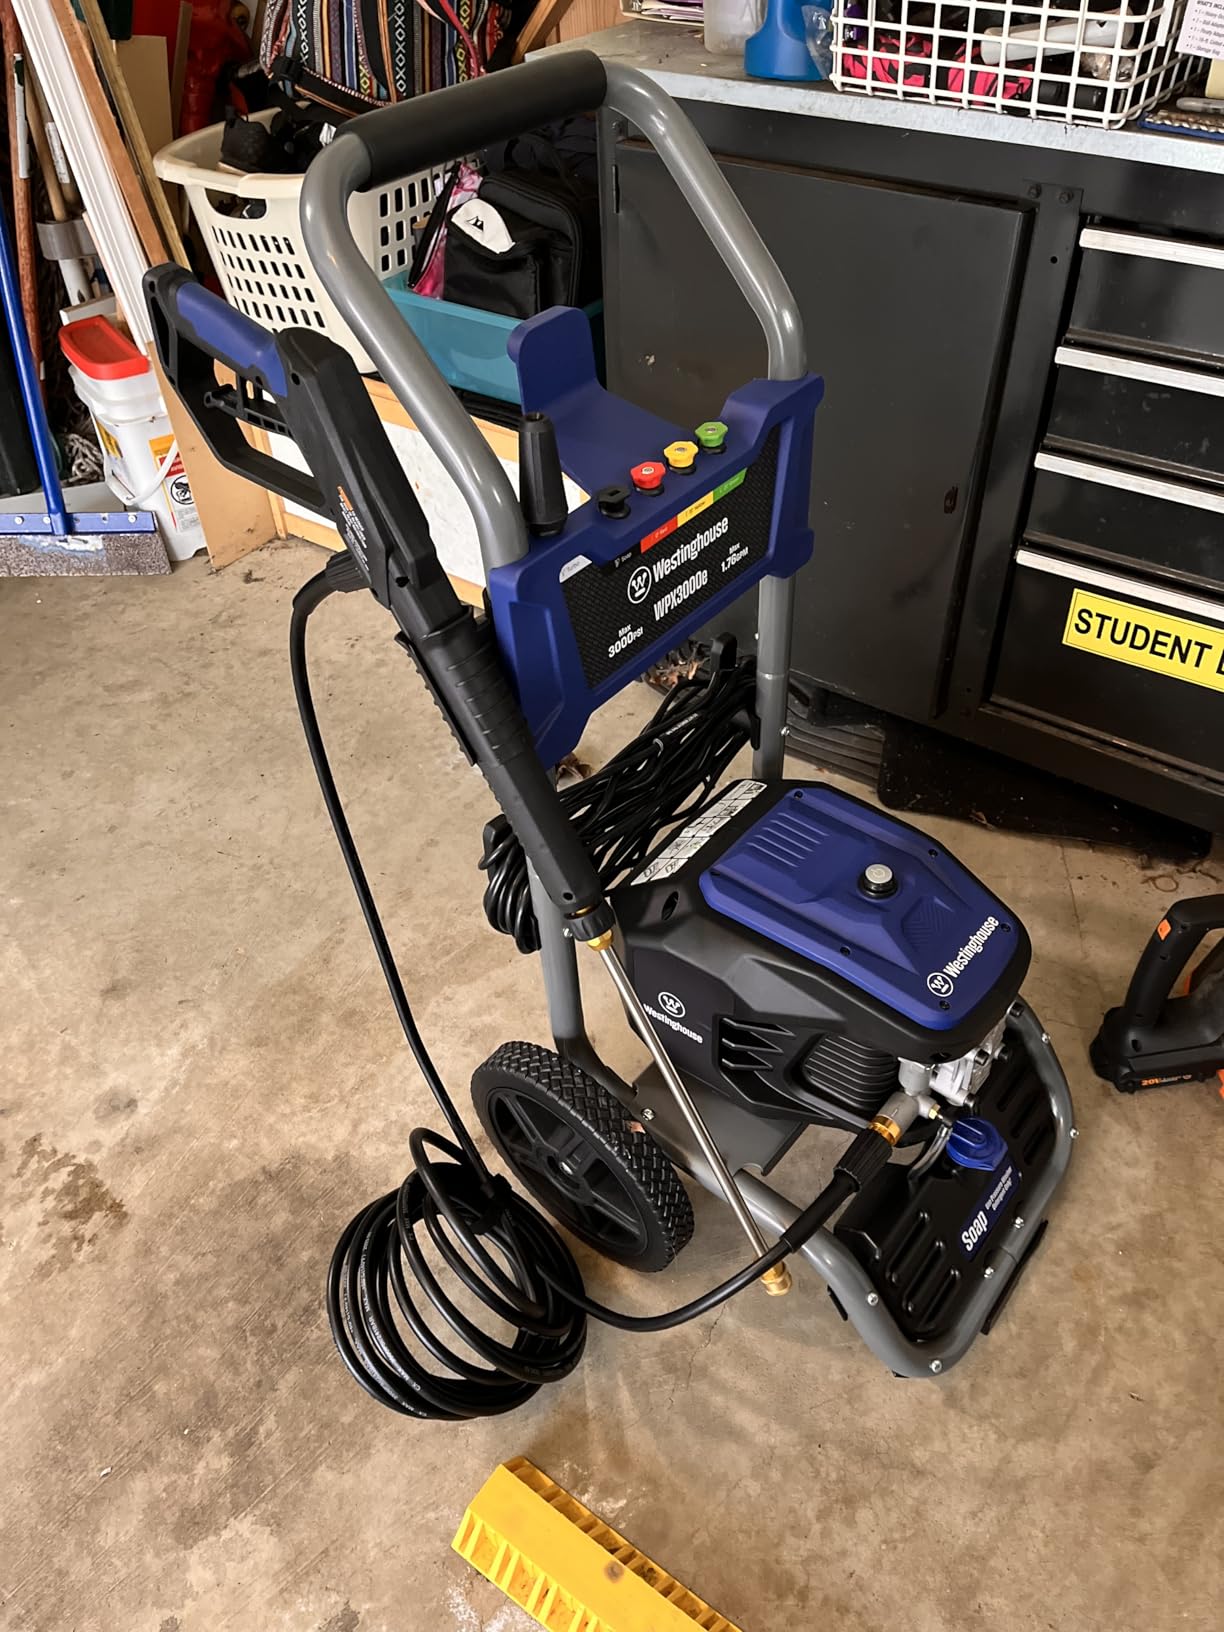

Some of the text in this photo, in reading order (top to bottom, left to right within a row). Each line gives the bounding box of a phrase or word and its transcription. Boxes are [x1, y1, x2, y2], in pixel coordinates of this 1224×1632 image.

[652, 517, 729, 583] Westinghouse
[653, 569, 708, 621] WPX3000e
[608, 626, 643, 658] 3000PSI
[618, 624, 632, 637] Max
[1074, 608, 1213, 668] STUDENT
[943, 916, 999, 978] Westinghouse
[643, 1003, 703, 1044] Westinghouse
[961, 1210, 988, 1251] Soap
